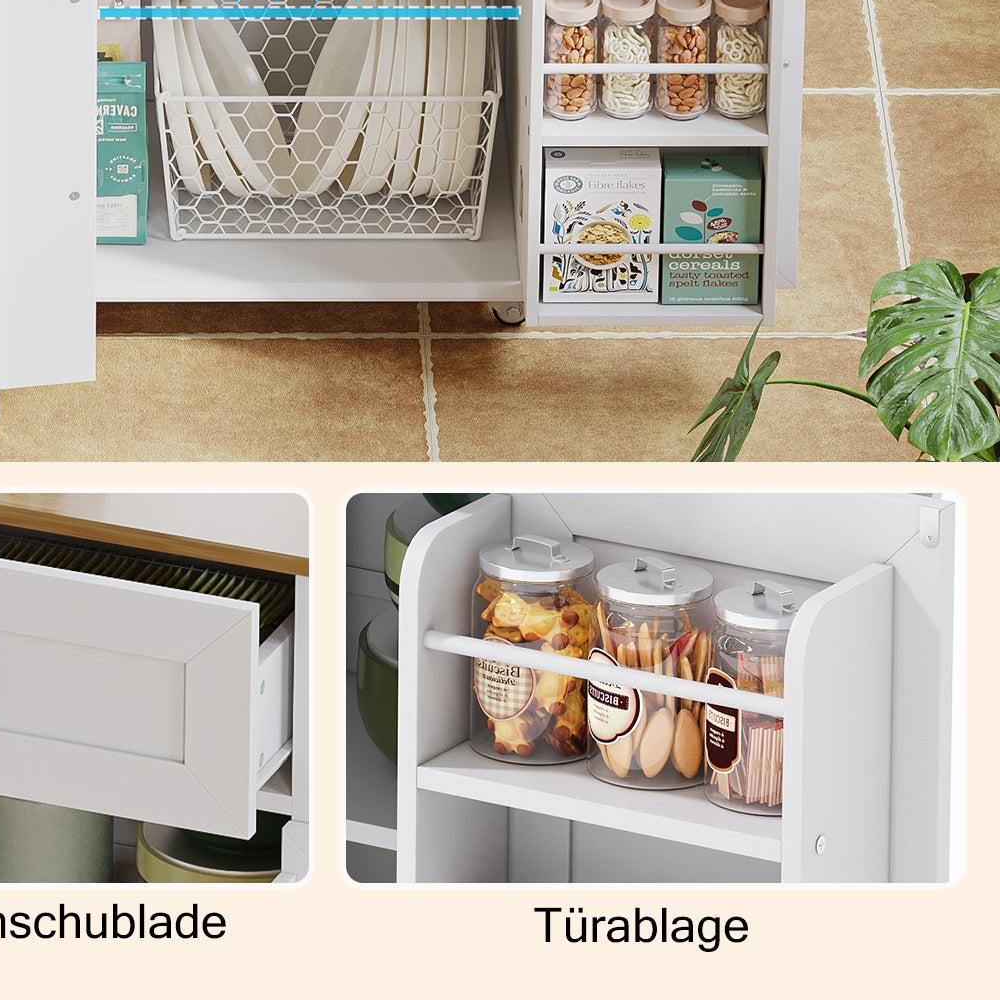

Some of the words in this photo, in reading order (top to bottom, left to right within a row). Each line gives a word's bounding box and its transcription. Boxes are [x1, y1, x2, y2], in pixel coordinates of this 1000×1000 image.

[588, 180, 614, 189] Fibre
[616, 180, 646, 189] flakes
[668, 259, 741, 270] cereals
[669, 272, 701, 280] tasty
[703, 271, 750, 279] toasted
[668, 280, 700, 288] spelt
[702, 279, 739, 287] flakes
